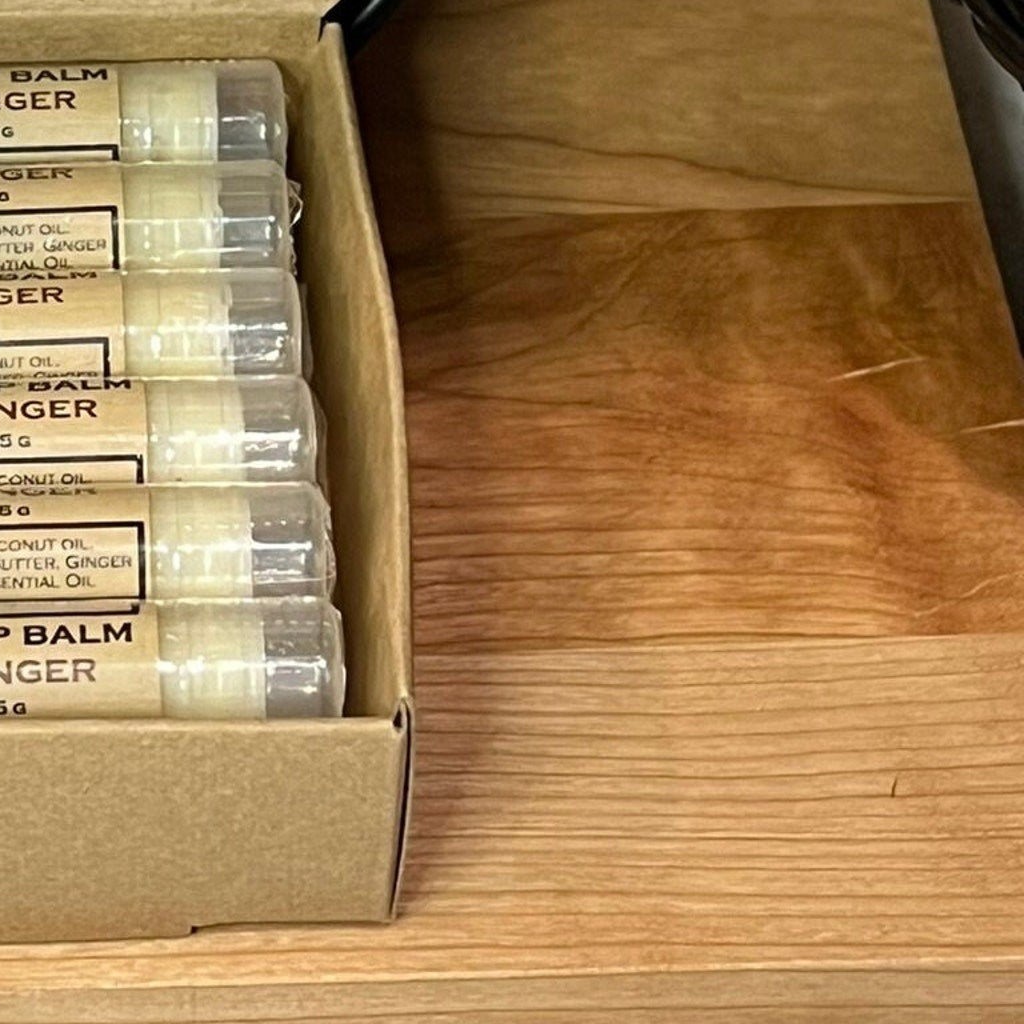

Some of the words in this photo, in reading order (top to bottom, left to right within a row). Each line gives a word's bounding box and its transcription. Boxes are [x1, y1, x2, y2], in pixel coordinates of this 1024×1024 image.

[10, 68, 108, 83] BALM
[42, 238, 108, 253] GINGER
[27, 378, 132, 392] BALM
[65, 555, 133, 570] GINGER
[65, 572, 96, 589] OIL
[23, 622, 133, 645] BALM
